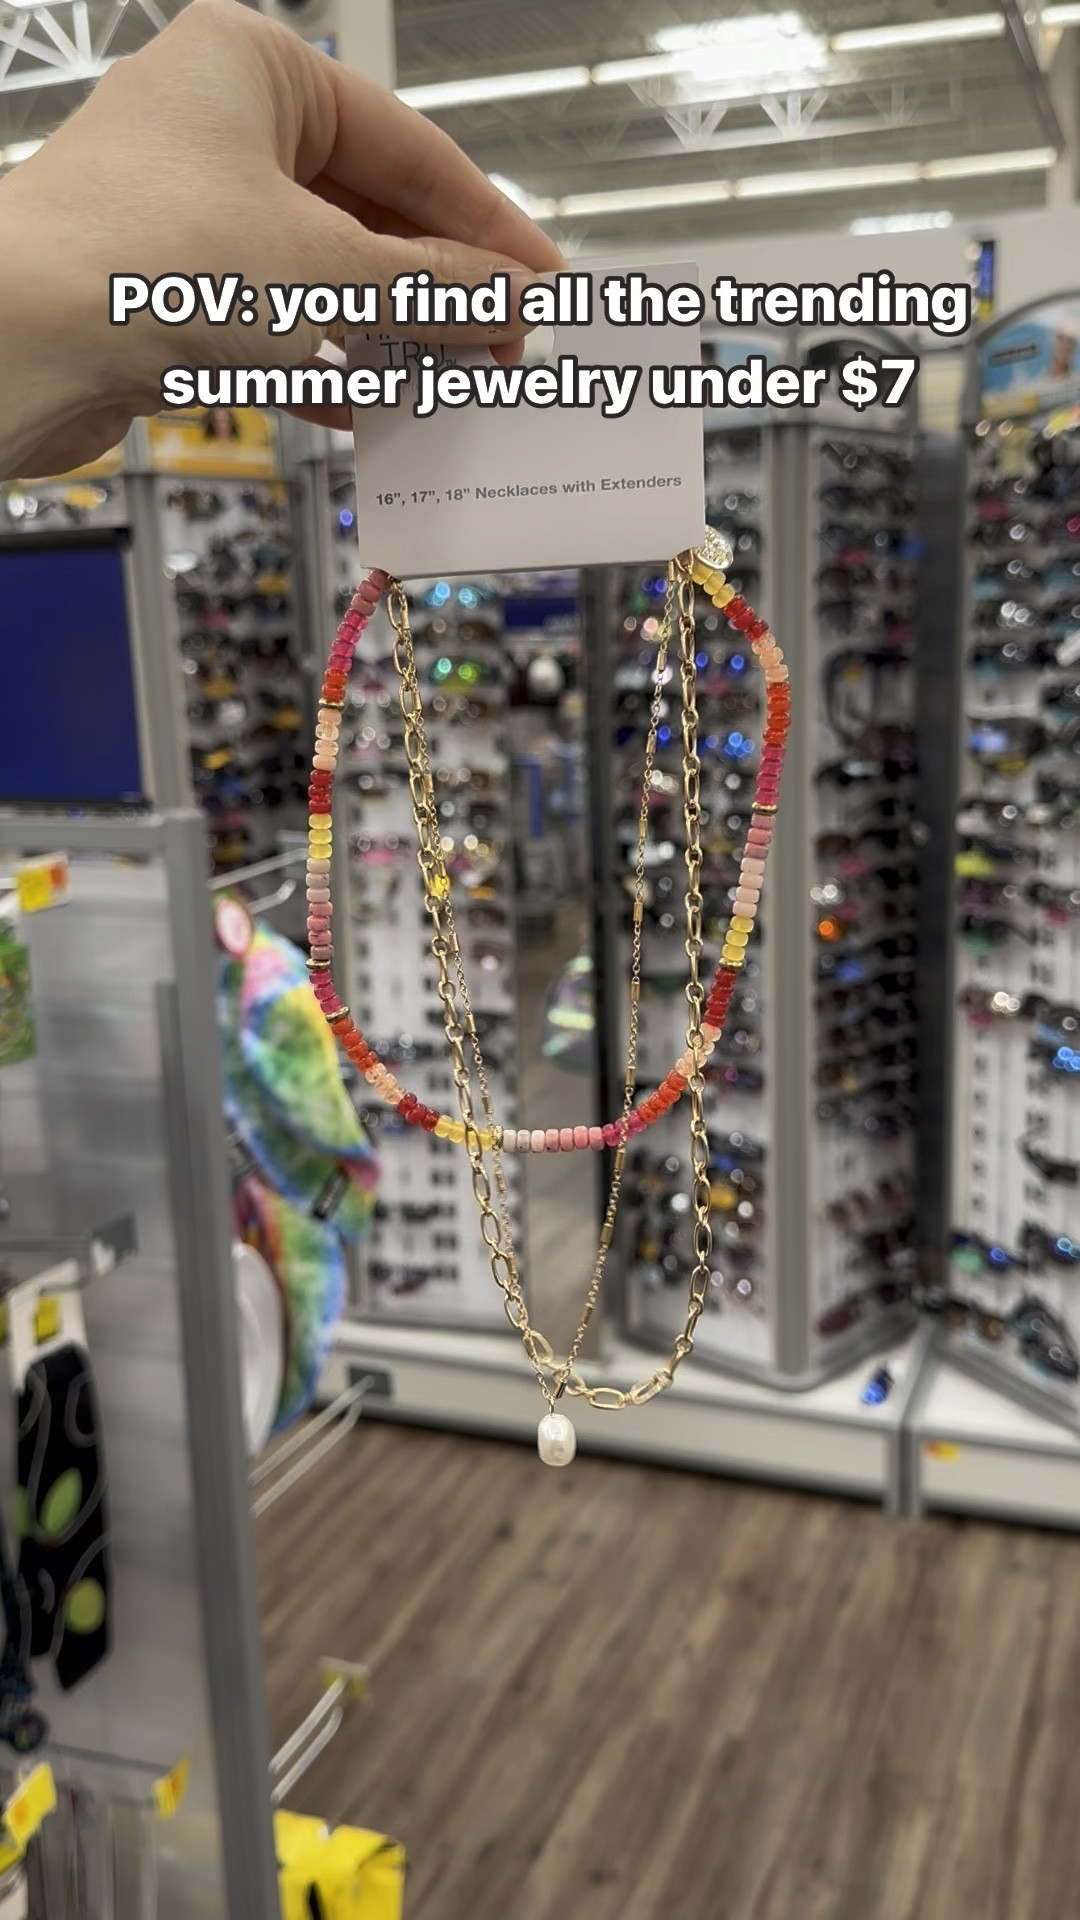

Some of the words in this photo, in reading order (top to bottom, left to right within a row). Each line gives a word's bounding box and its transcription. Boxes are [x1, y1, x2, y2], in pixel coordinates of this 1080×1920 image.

[475, 484, 558, 499] Necklaces
[562, 480, 596, 493] with
[601, 475, 682, 491] Extenders
